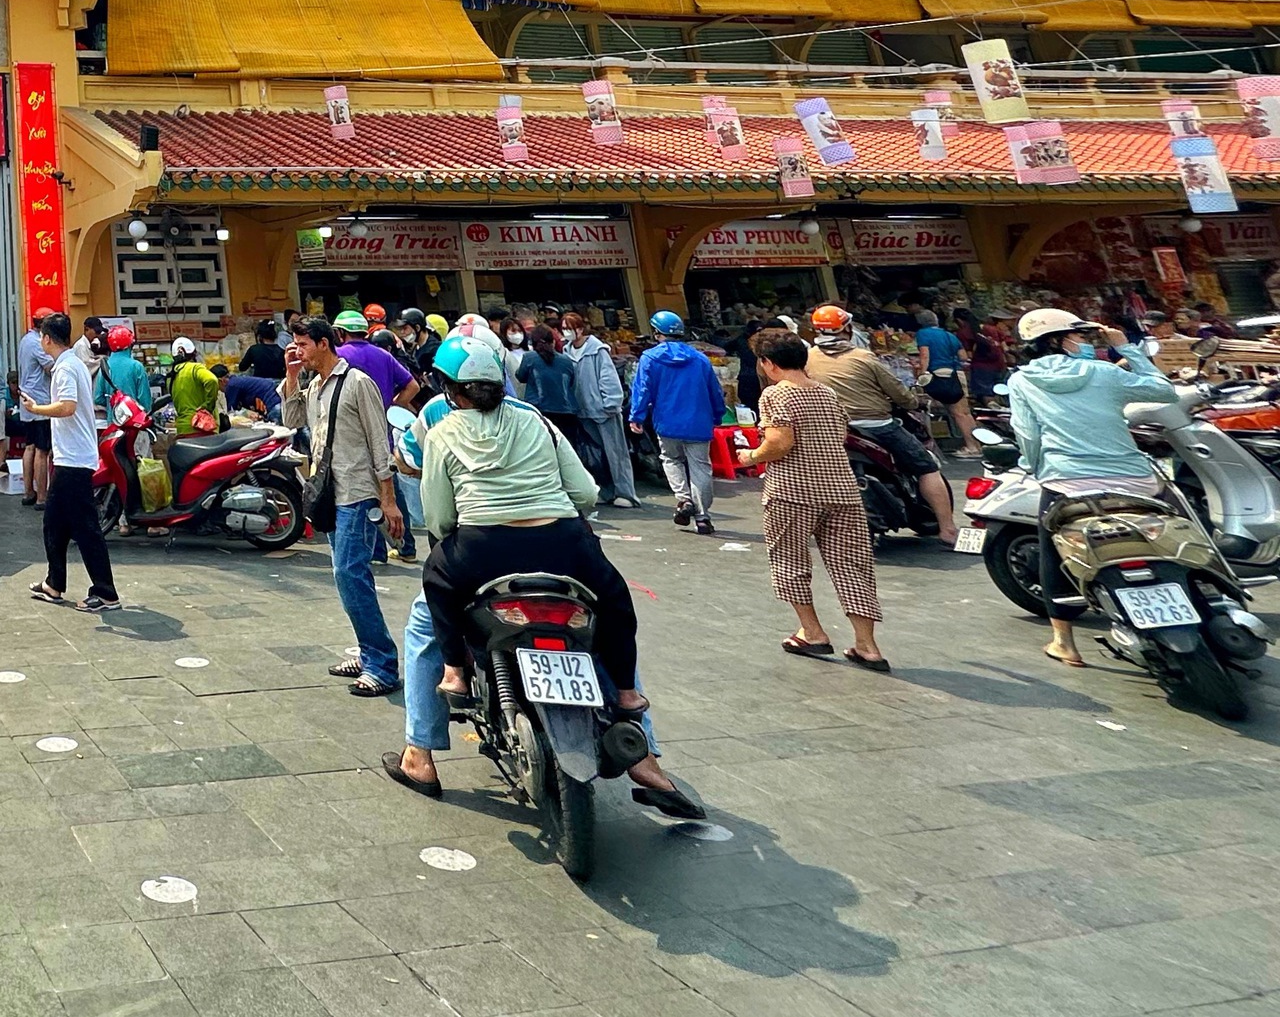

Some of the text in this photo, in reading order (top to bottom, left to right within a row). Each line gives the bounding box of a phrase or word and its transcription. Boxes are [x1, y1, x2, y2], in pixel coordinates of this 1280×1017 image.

[393, 233, 452, 250] Trúc
[471, 232, 487, 241] 16
[498, 225, 618, 247] KIM HẠNH
[743, 229, 809, 248] PHỤNG
[855, 231, 909, 249] Giác
[532, 259, 547, 267] 229
[549, 258, 570, 267] (Zalo)
[615, 258, 629, 266] 217
[1133, 604, 1194, 625] 992.63
[529, 654, 585, 678] 59-U2
[529, 677, 595, 702] 521.83
